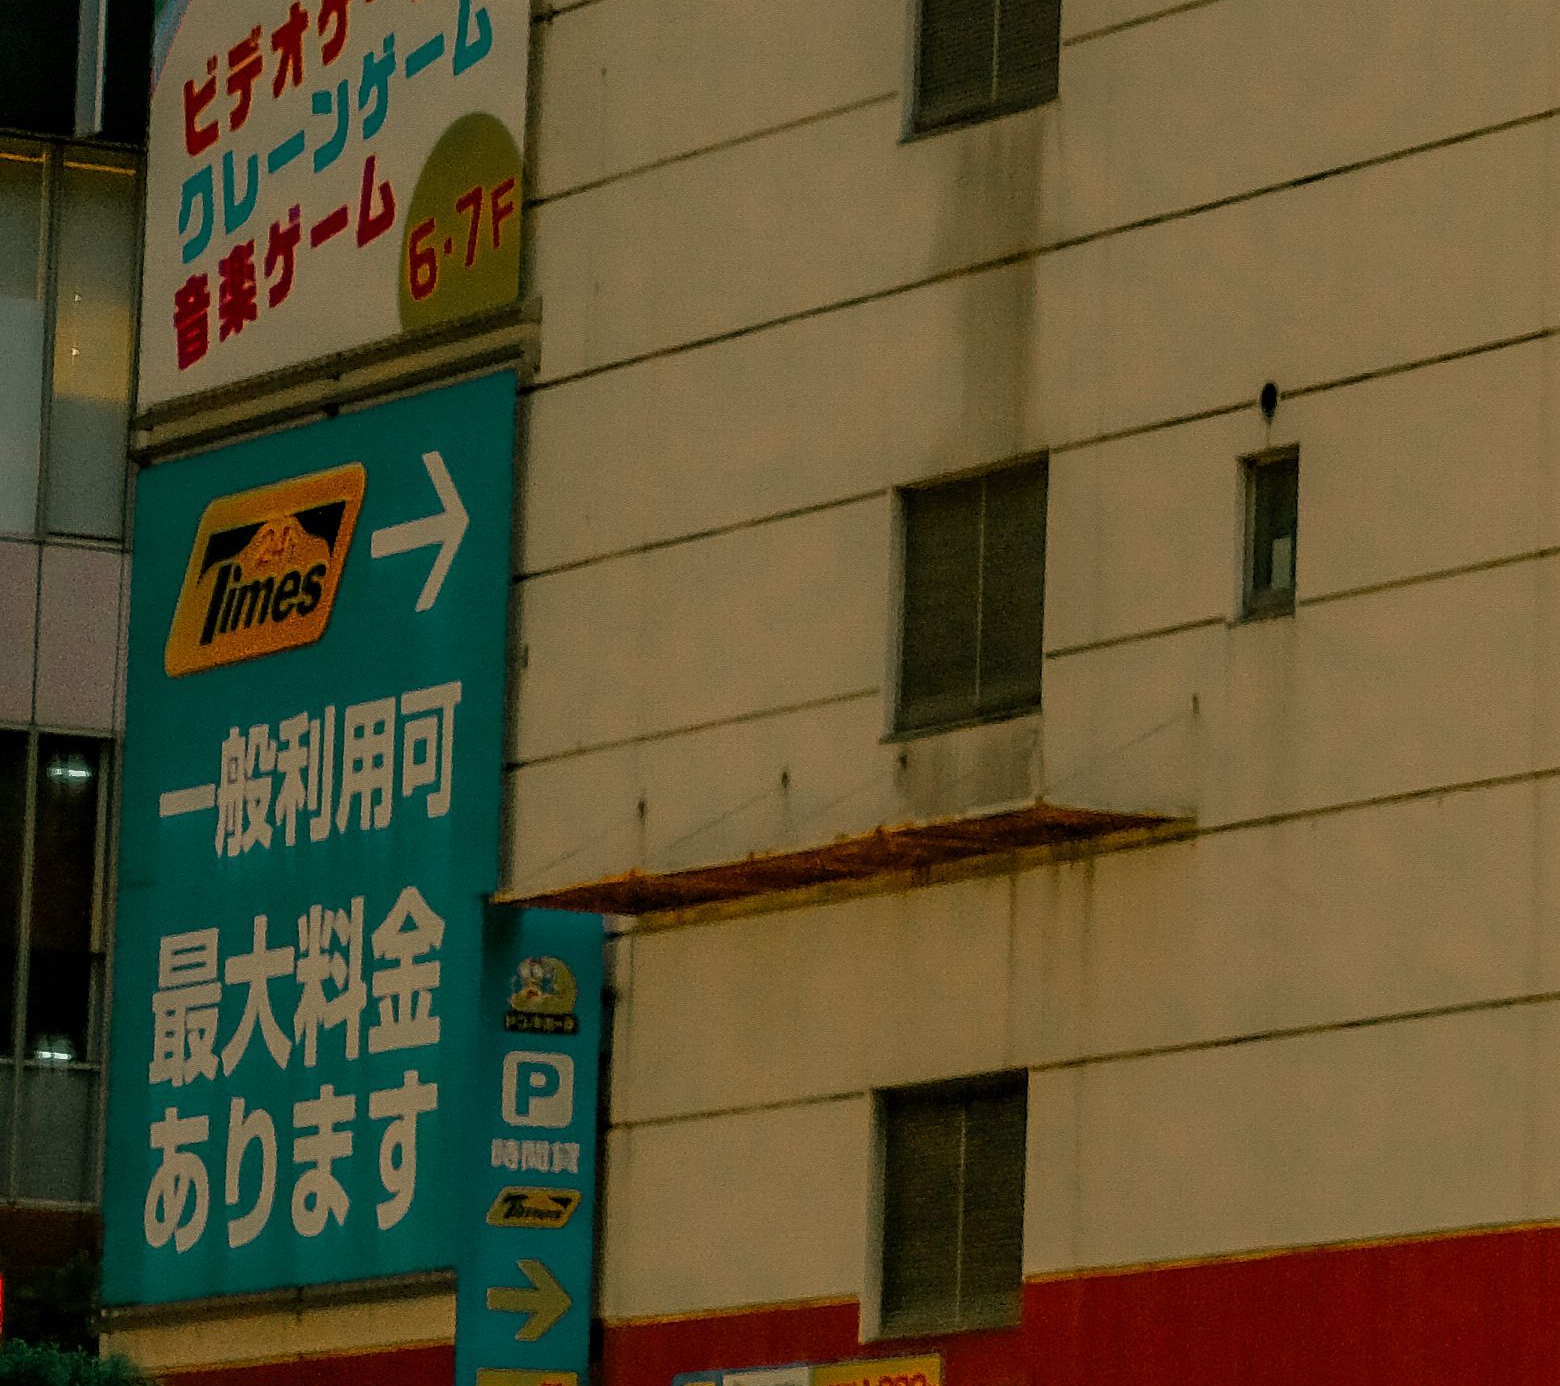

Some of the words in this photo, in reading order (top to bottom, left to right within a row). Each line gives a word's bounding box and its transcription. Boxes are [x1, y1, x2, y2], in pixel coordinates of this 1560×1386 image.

[173, 153, 396, 371] 音楽ゲーム
[199, 562, 327, 645] Times
[159, 682, 462, 858] 一般利用可
[148, 885, 445, 1088] 最大料金
[142, 1068, 439, 1253] あります
[515, 1062, 560, 1117] P
